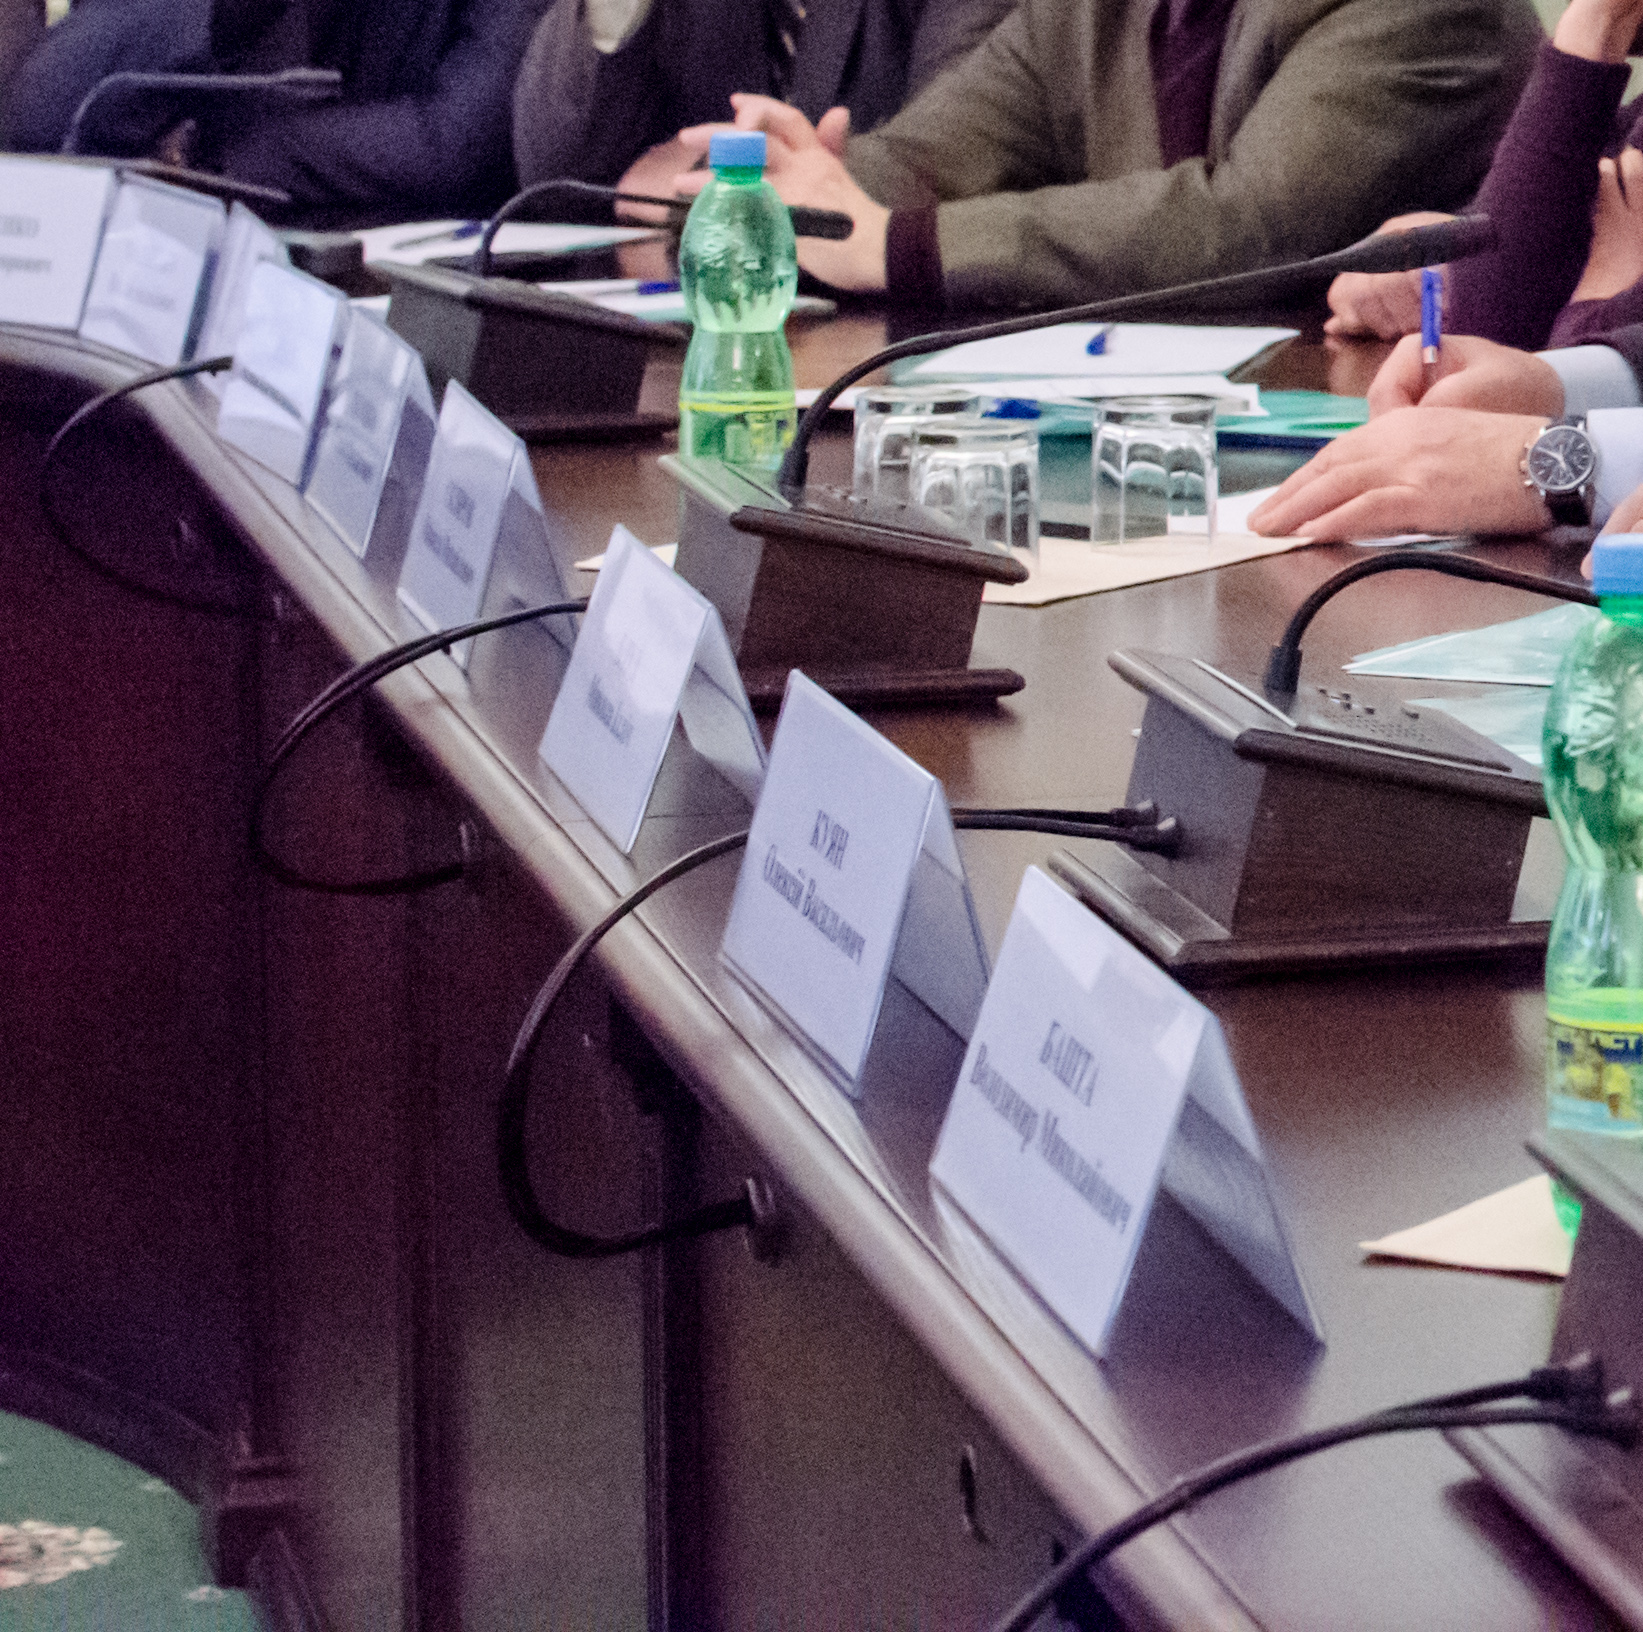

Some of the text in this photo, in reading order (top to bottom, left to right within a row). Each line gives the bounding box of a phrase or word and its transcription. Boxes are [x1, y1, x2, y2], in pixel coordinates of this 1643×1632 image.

[810, 809, 850, 870] КУЯН
[801, 878, 866, 966] Васильович
[1038, 1019, 1099, 1108] БАШТА
